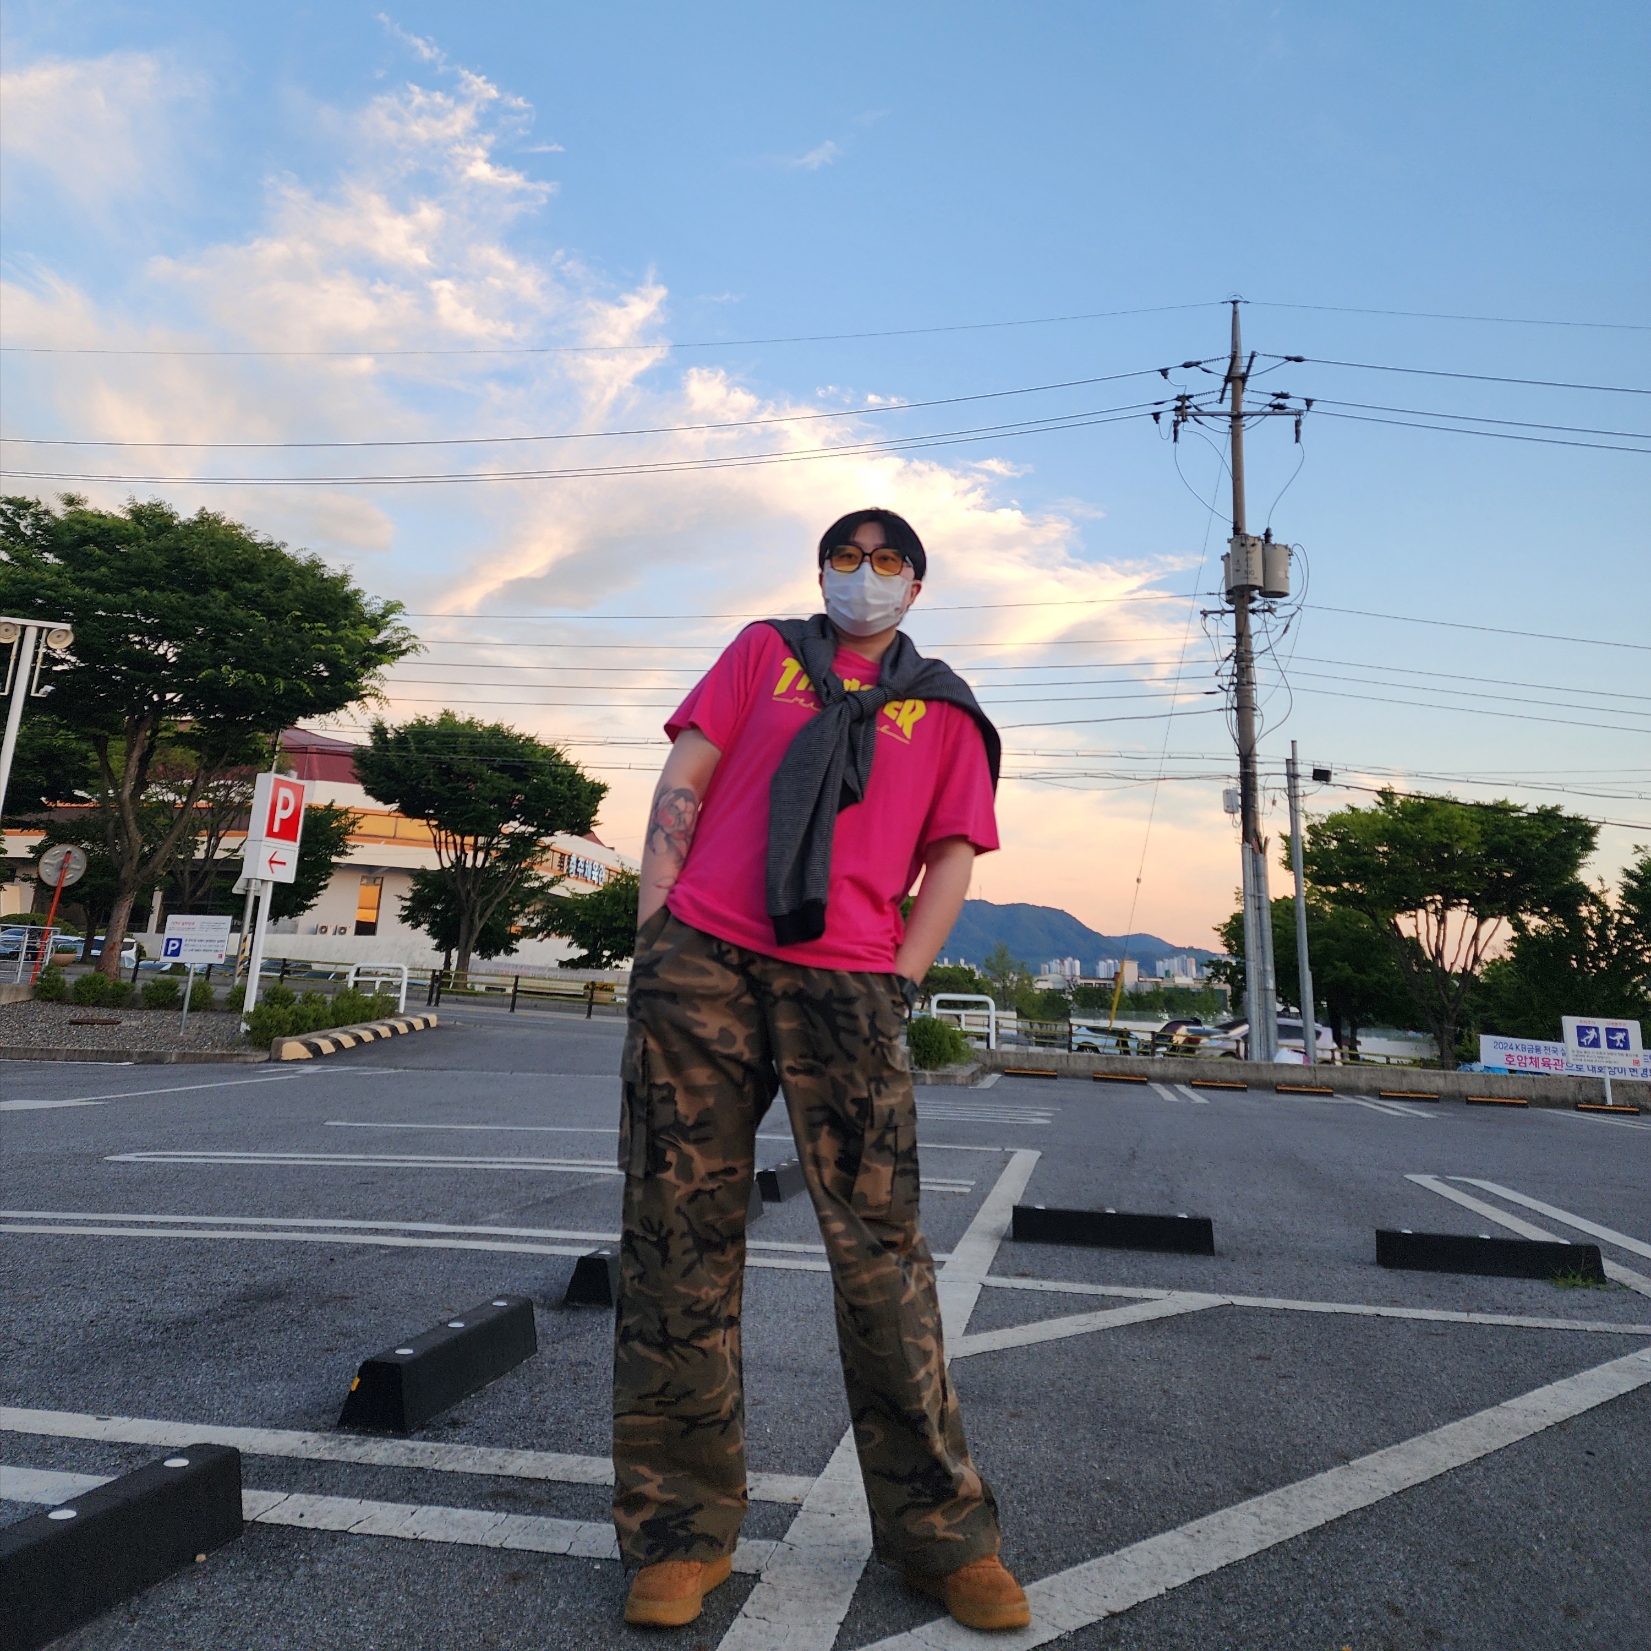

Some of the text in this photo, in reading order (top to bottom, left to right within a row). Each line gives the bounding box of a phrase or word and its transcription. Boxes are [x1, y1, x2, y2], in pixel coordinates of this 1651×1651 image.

[272, 787, 295, 833] P
[167, 940, 180, 955] P
[1493, 1041, 1514, 1051] 2024
[1515, 1044, 1542, 1055] KB금융
[1543, 1046, 1559, 1056] 전국
